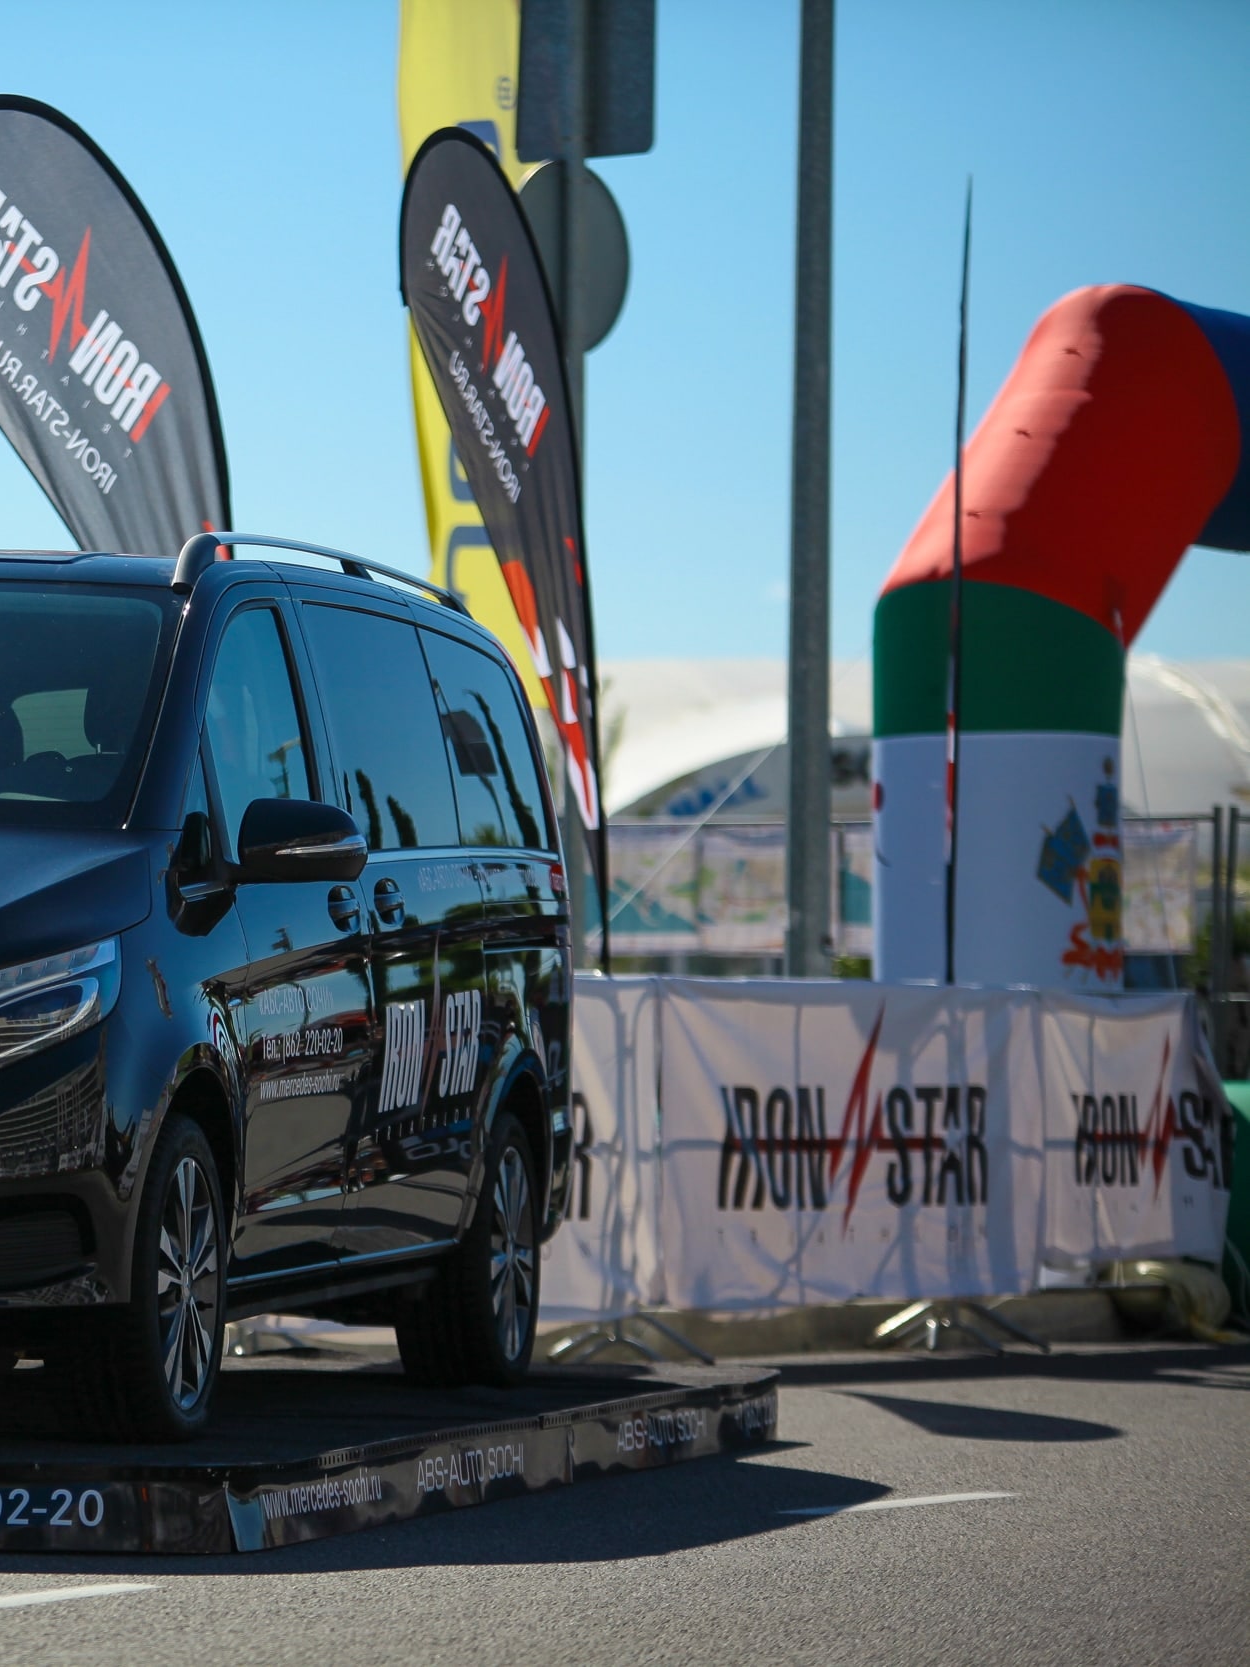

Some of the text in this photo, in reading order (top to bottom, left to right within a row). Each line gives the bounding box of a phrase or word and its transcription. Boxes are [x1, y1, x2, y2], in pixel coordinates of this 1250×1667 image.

[304, 1027, 344, 1056] 220-02-20
[377, 989, 482, 1113] IRON STAR
[716, 1086, 828, 1213] IRON
[885, 1085, 989, 1210] STAR
[261, 1467, 383, 1520] www.mercedes-sochi.ru
[416, 1443, 525, 1493] ABS-AUTO SOCHI
